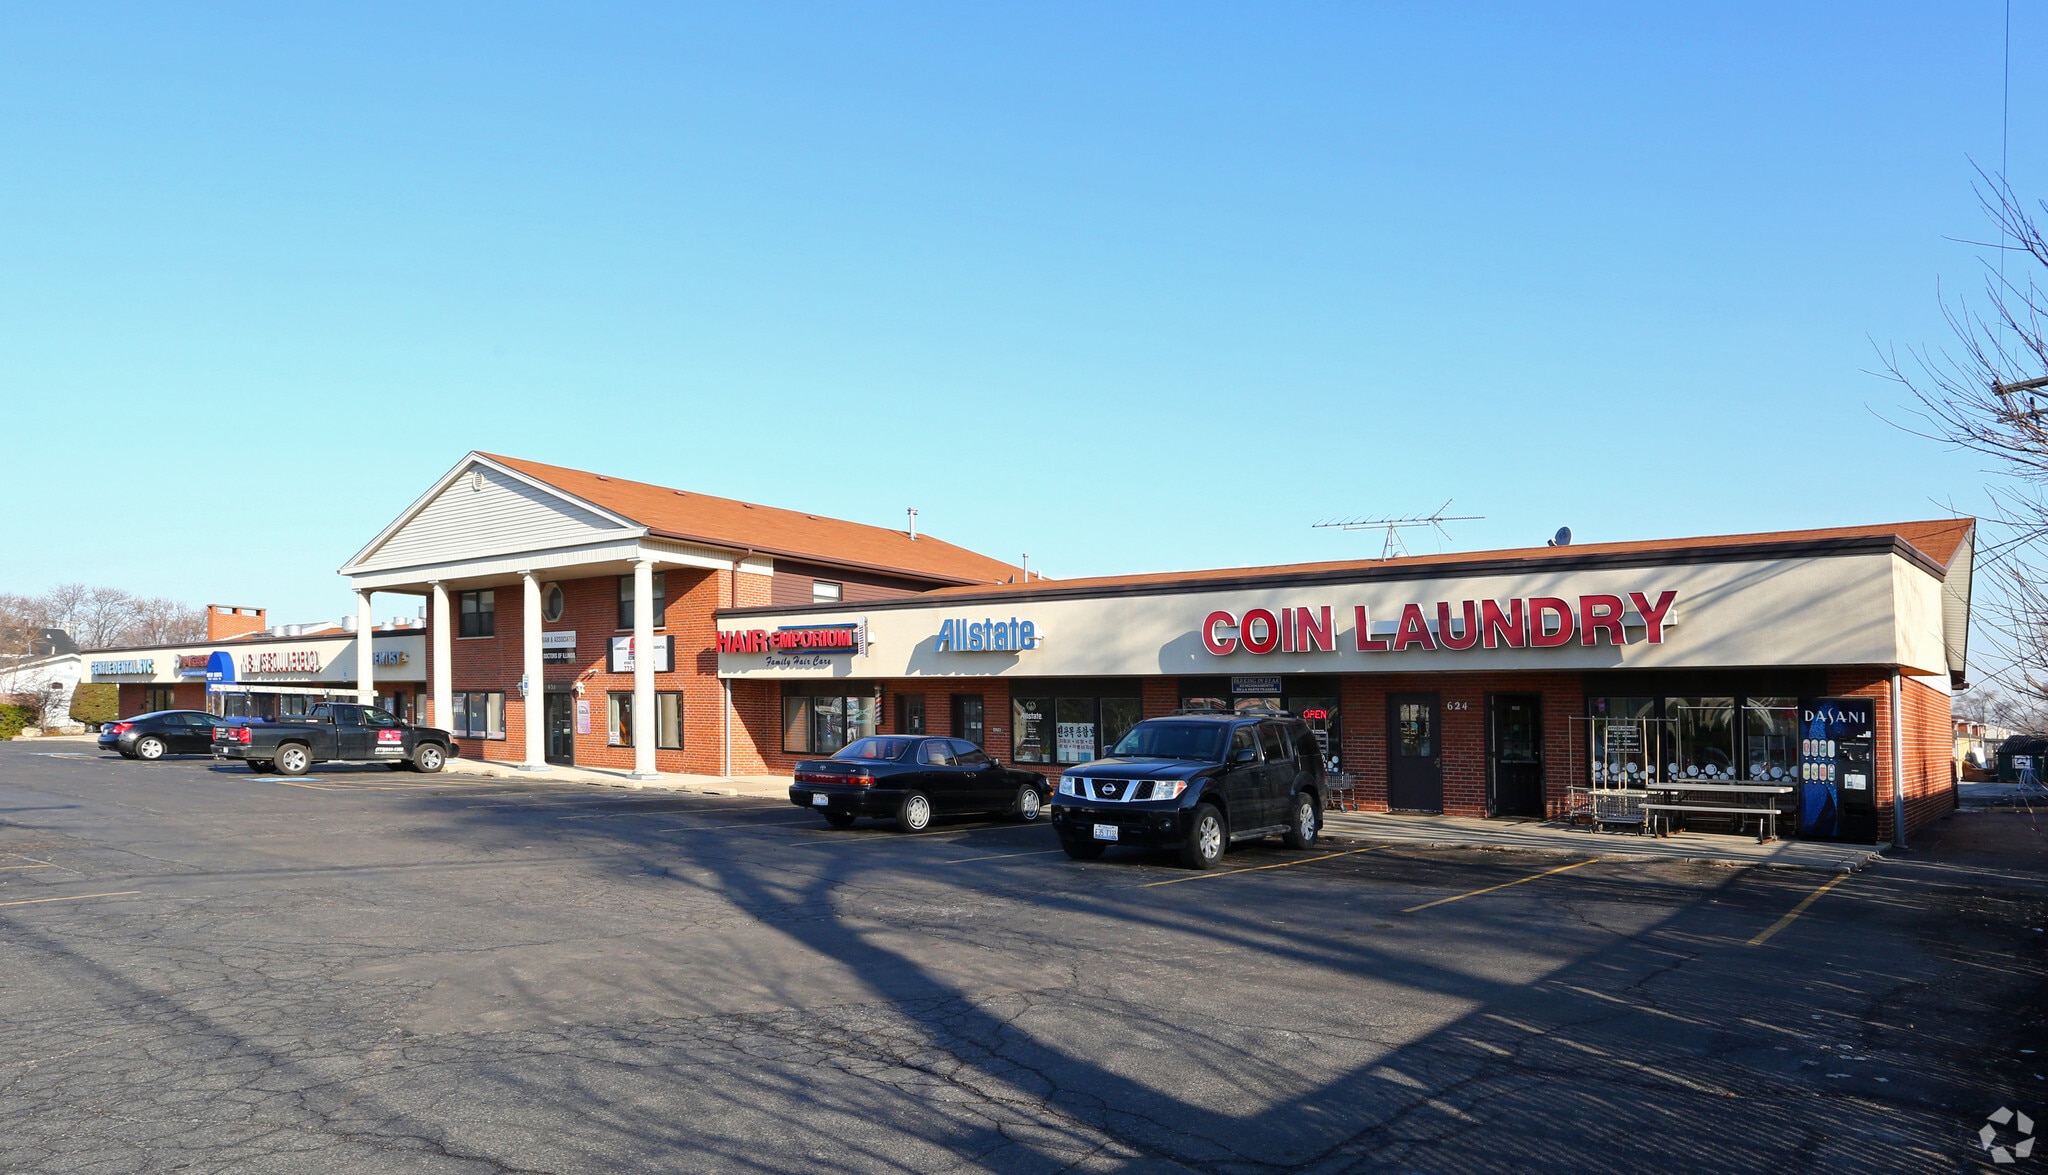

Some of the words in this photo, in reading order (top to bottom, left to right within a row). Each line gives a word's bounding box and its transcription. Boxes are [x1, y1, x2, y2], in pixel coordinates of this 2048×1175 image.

[1202, 604, 1337, 657] COIN
[1353, 590, 1679, 652] LAUNDRY
[716, 629, 769, 653] HAIR
[770, 629, 853, 648] EMPORIUM
[934, 616, 1035, 652] Allstate
[766, 656, 790, 667] Family
[792, 656, 811, 666] Hair
[812, 656, 832, 666] Care
[1303, 709, 1327, 719] OPEN
[1447, 702, 1468, 710] 624
[1804, 708, 1866, 726] DASANI
